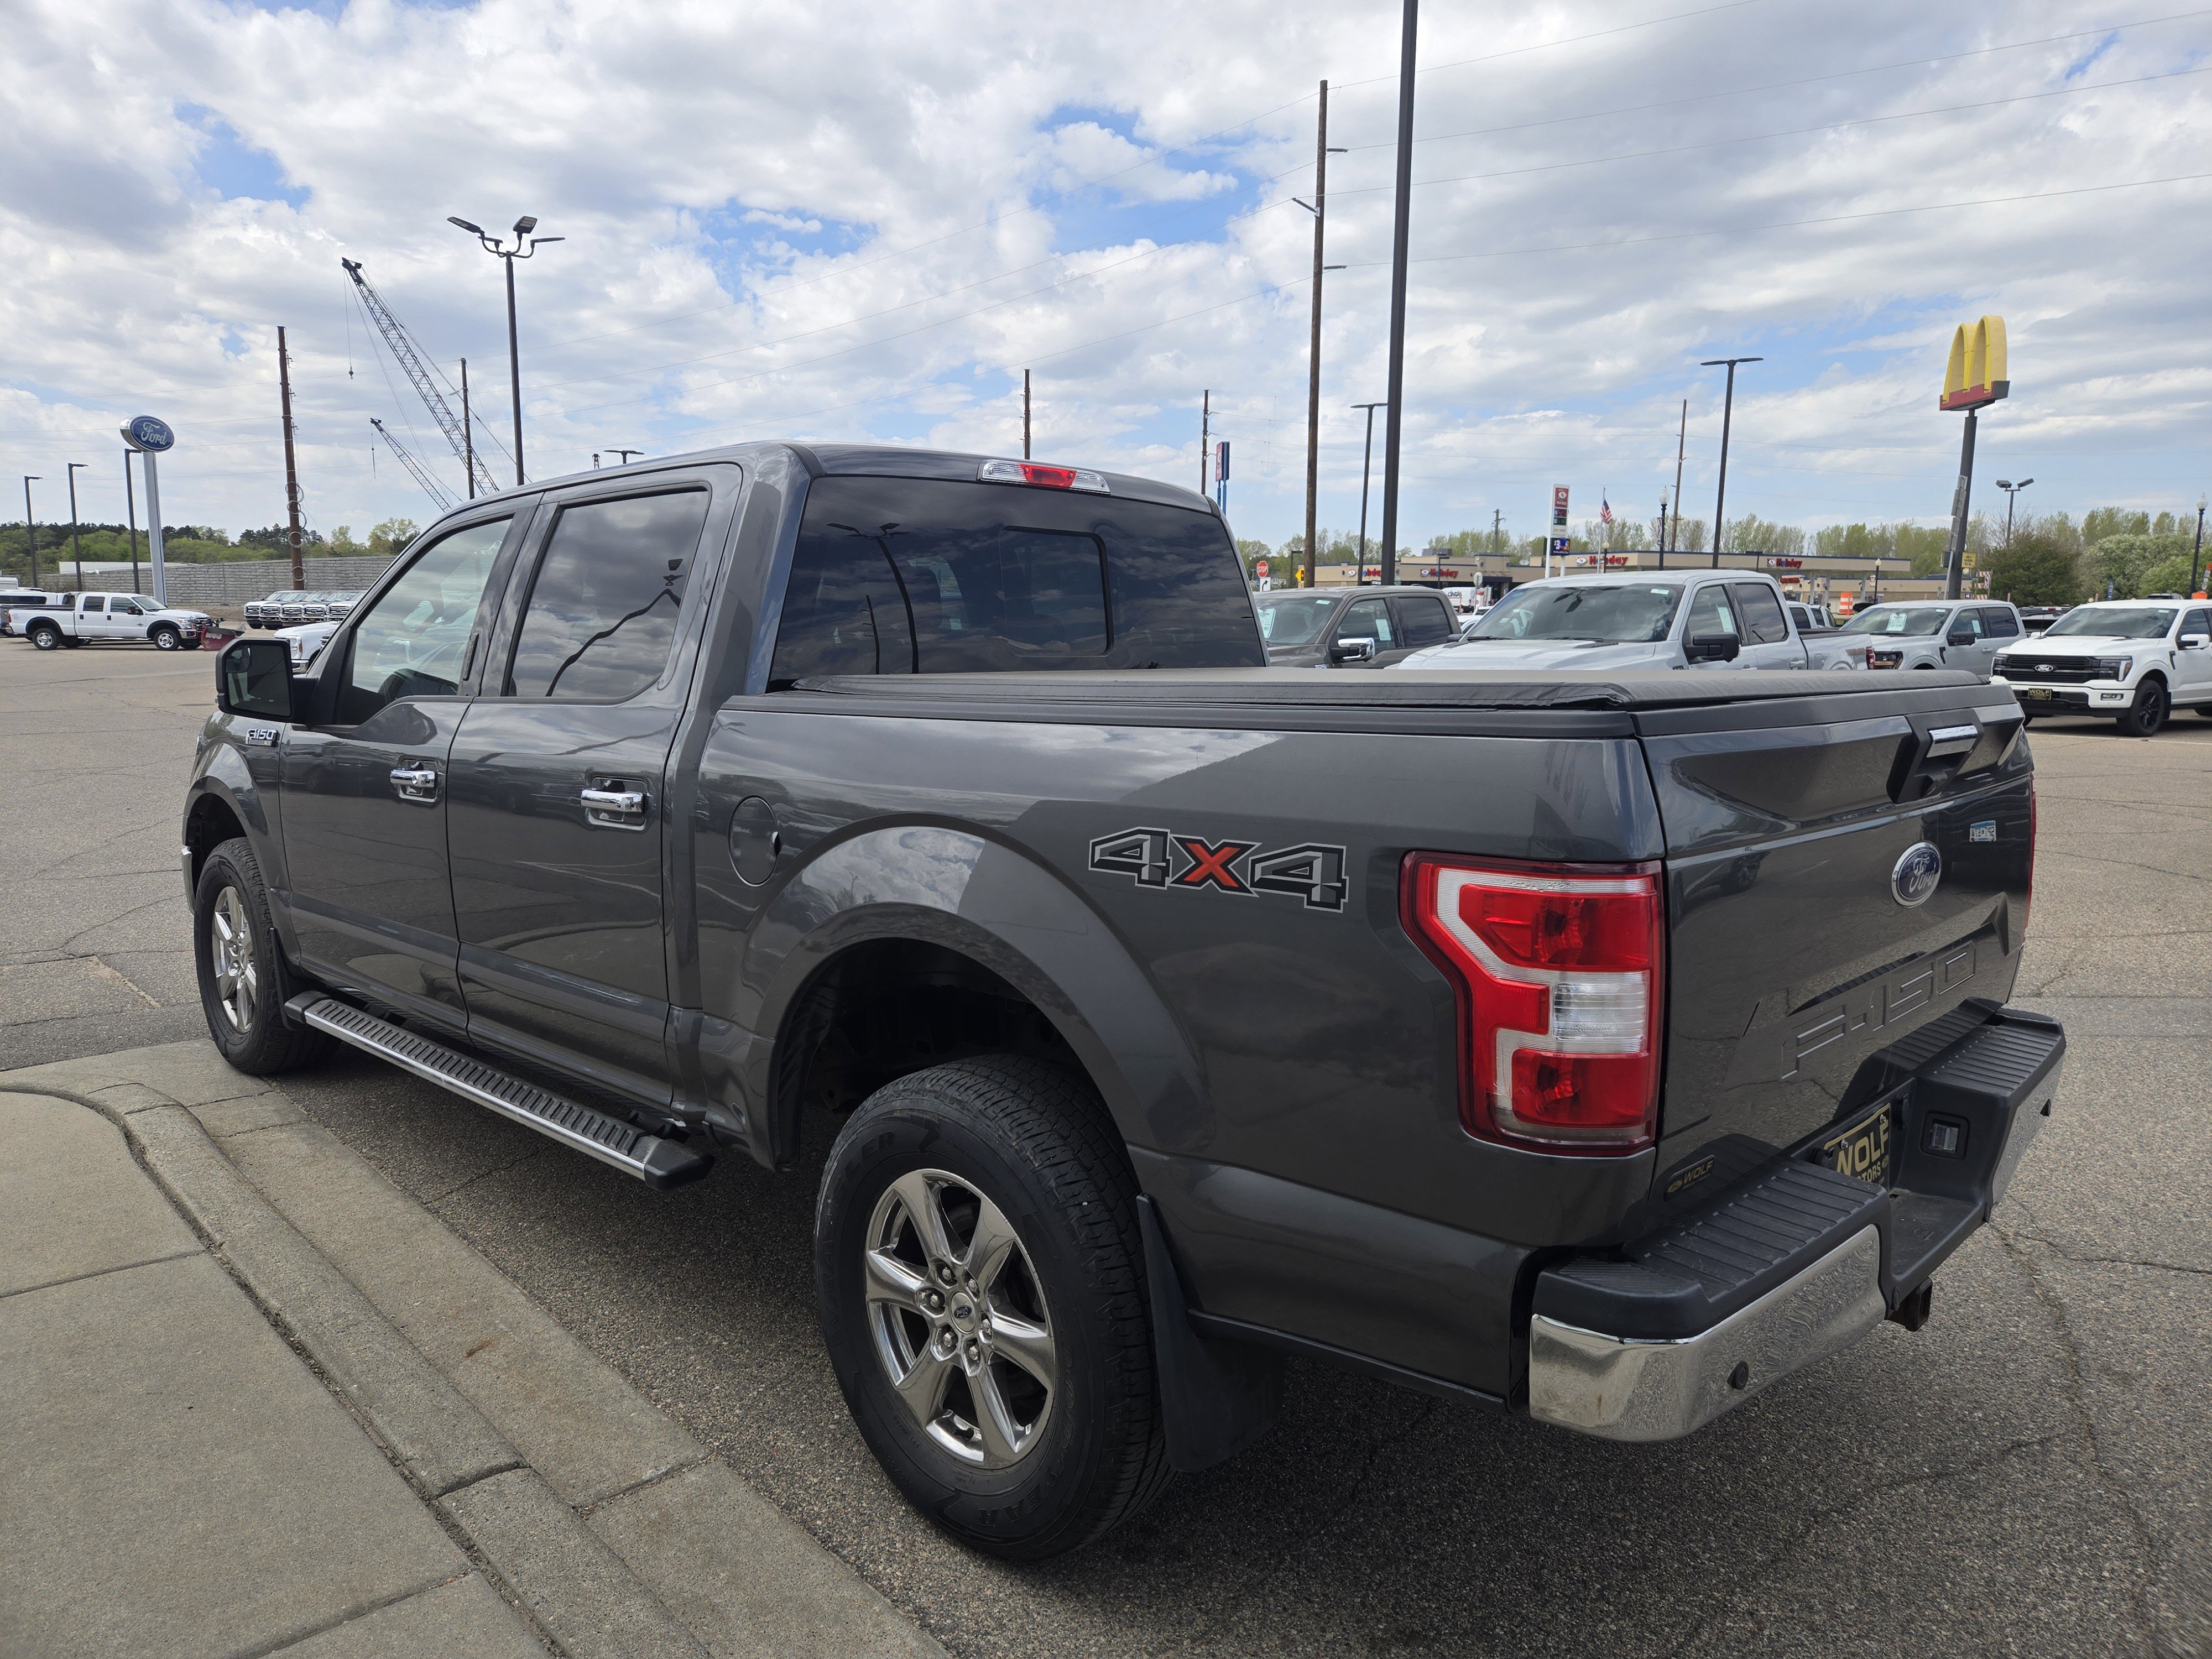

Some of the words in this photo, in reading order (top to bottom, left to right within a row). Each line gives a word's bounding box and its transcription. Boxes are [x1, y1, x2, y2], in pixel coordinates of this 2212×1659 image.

[140, 422, 167, 445] Ford
[1776, 558, 1803, 569] Holiday
[1908, 855, 1937, 894] Ford
[1781, 941, 1977, 1079] F-150
[1684, 1160, 1714, 1184] WOLF
[956, 1307, 968, 1318] Ford
